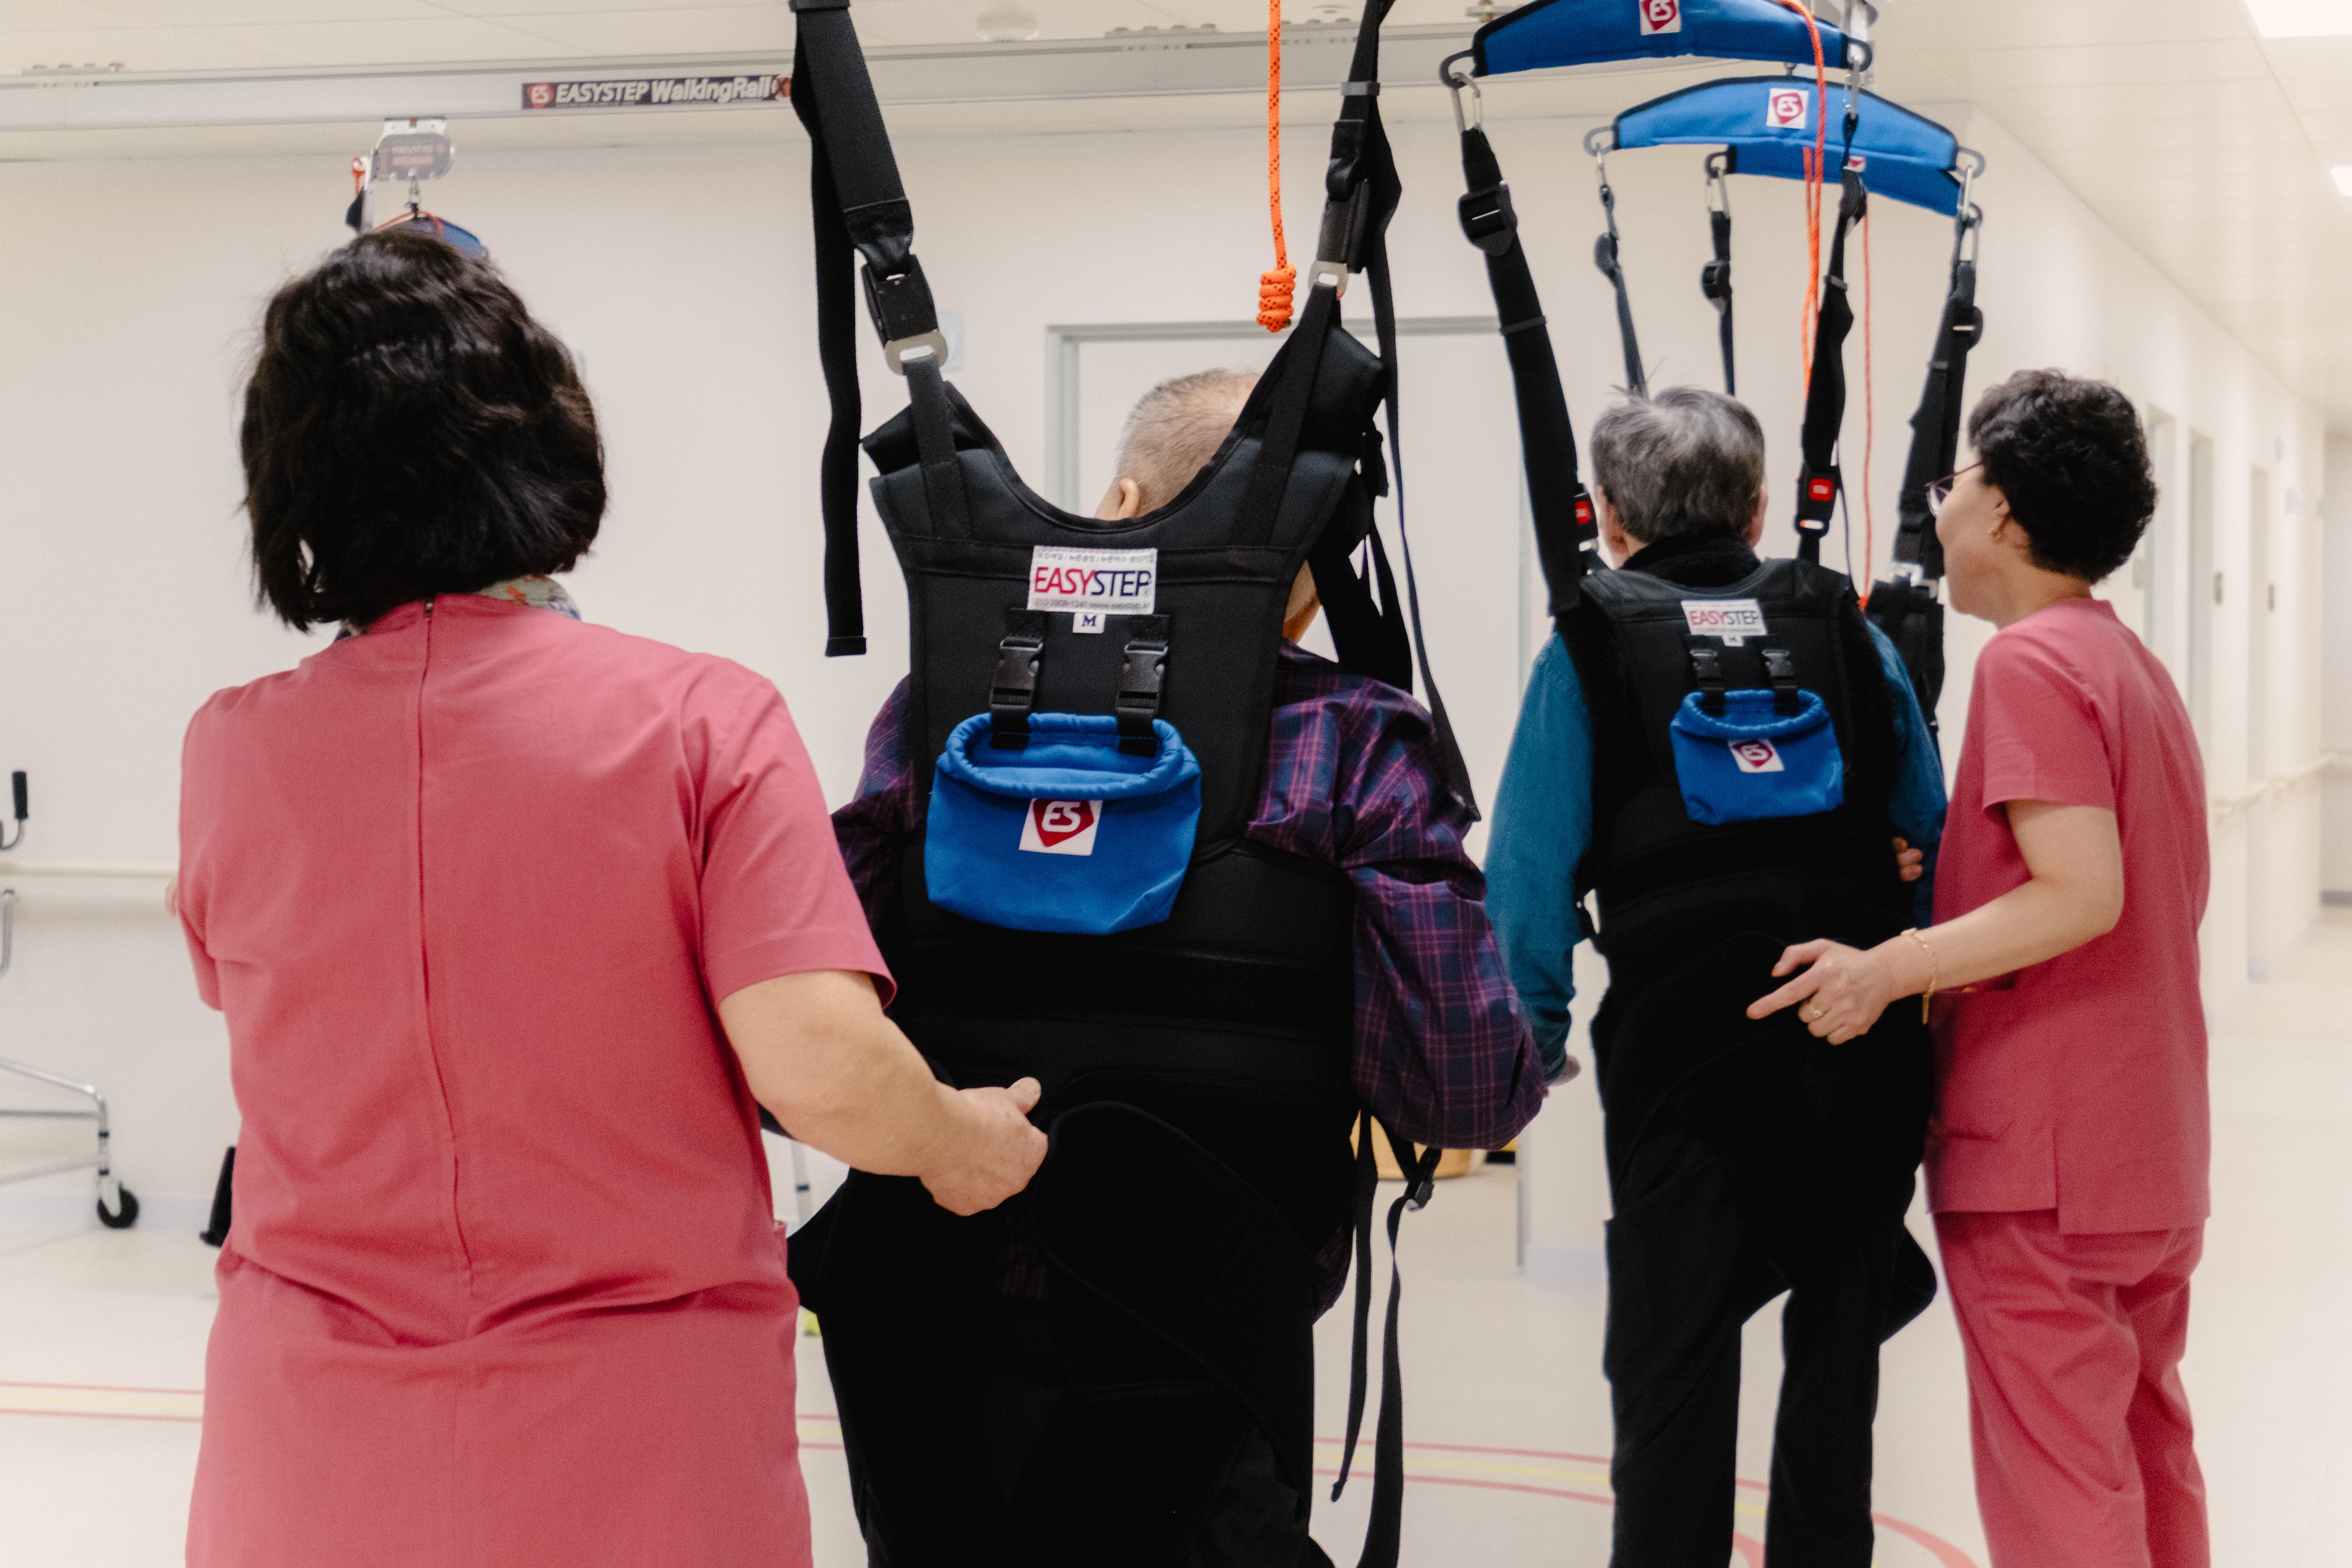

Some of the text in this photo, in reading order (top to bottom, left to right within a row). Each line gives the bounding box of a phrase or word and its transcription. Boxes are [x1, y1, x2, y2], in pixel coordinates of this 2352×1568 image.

[555, 76, 772, 104] EASYSTEP WalkingRail
[1034, 566, 1151, 597] EASYSTEP
[1082, 615, 1097, 627] M
[1689, 610, 1759, 625] EASYSTEP
[1041, 801, 1081, 833] ES
